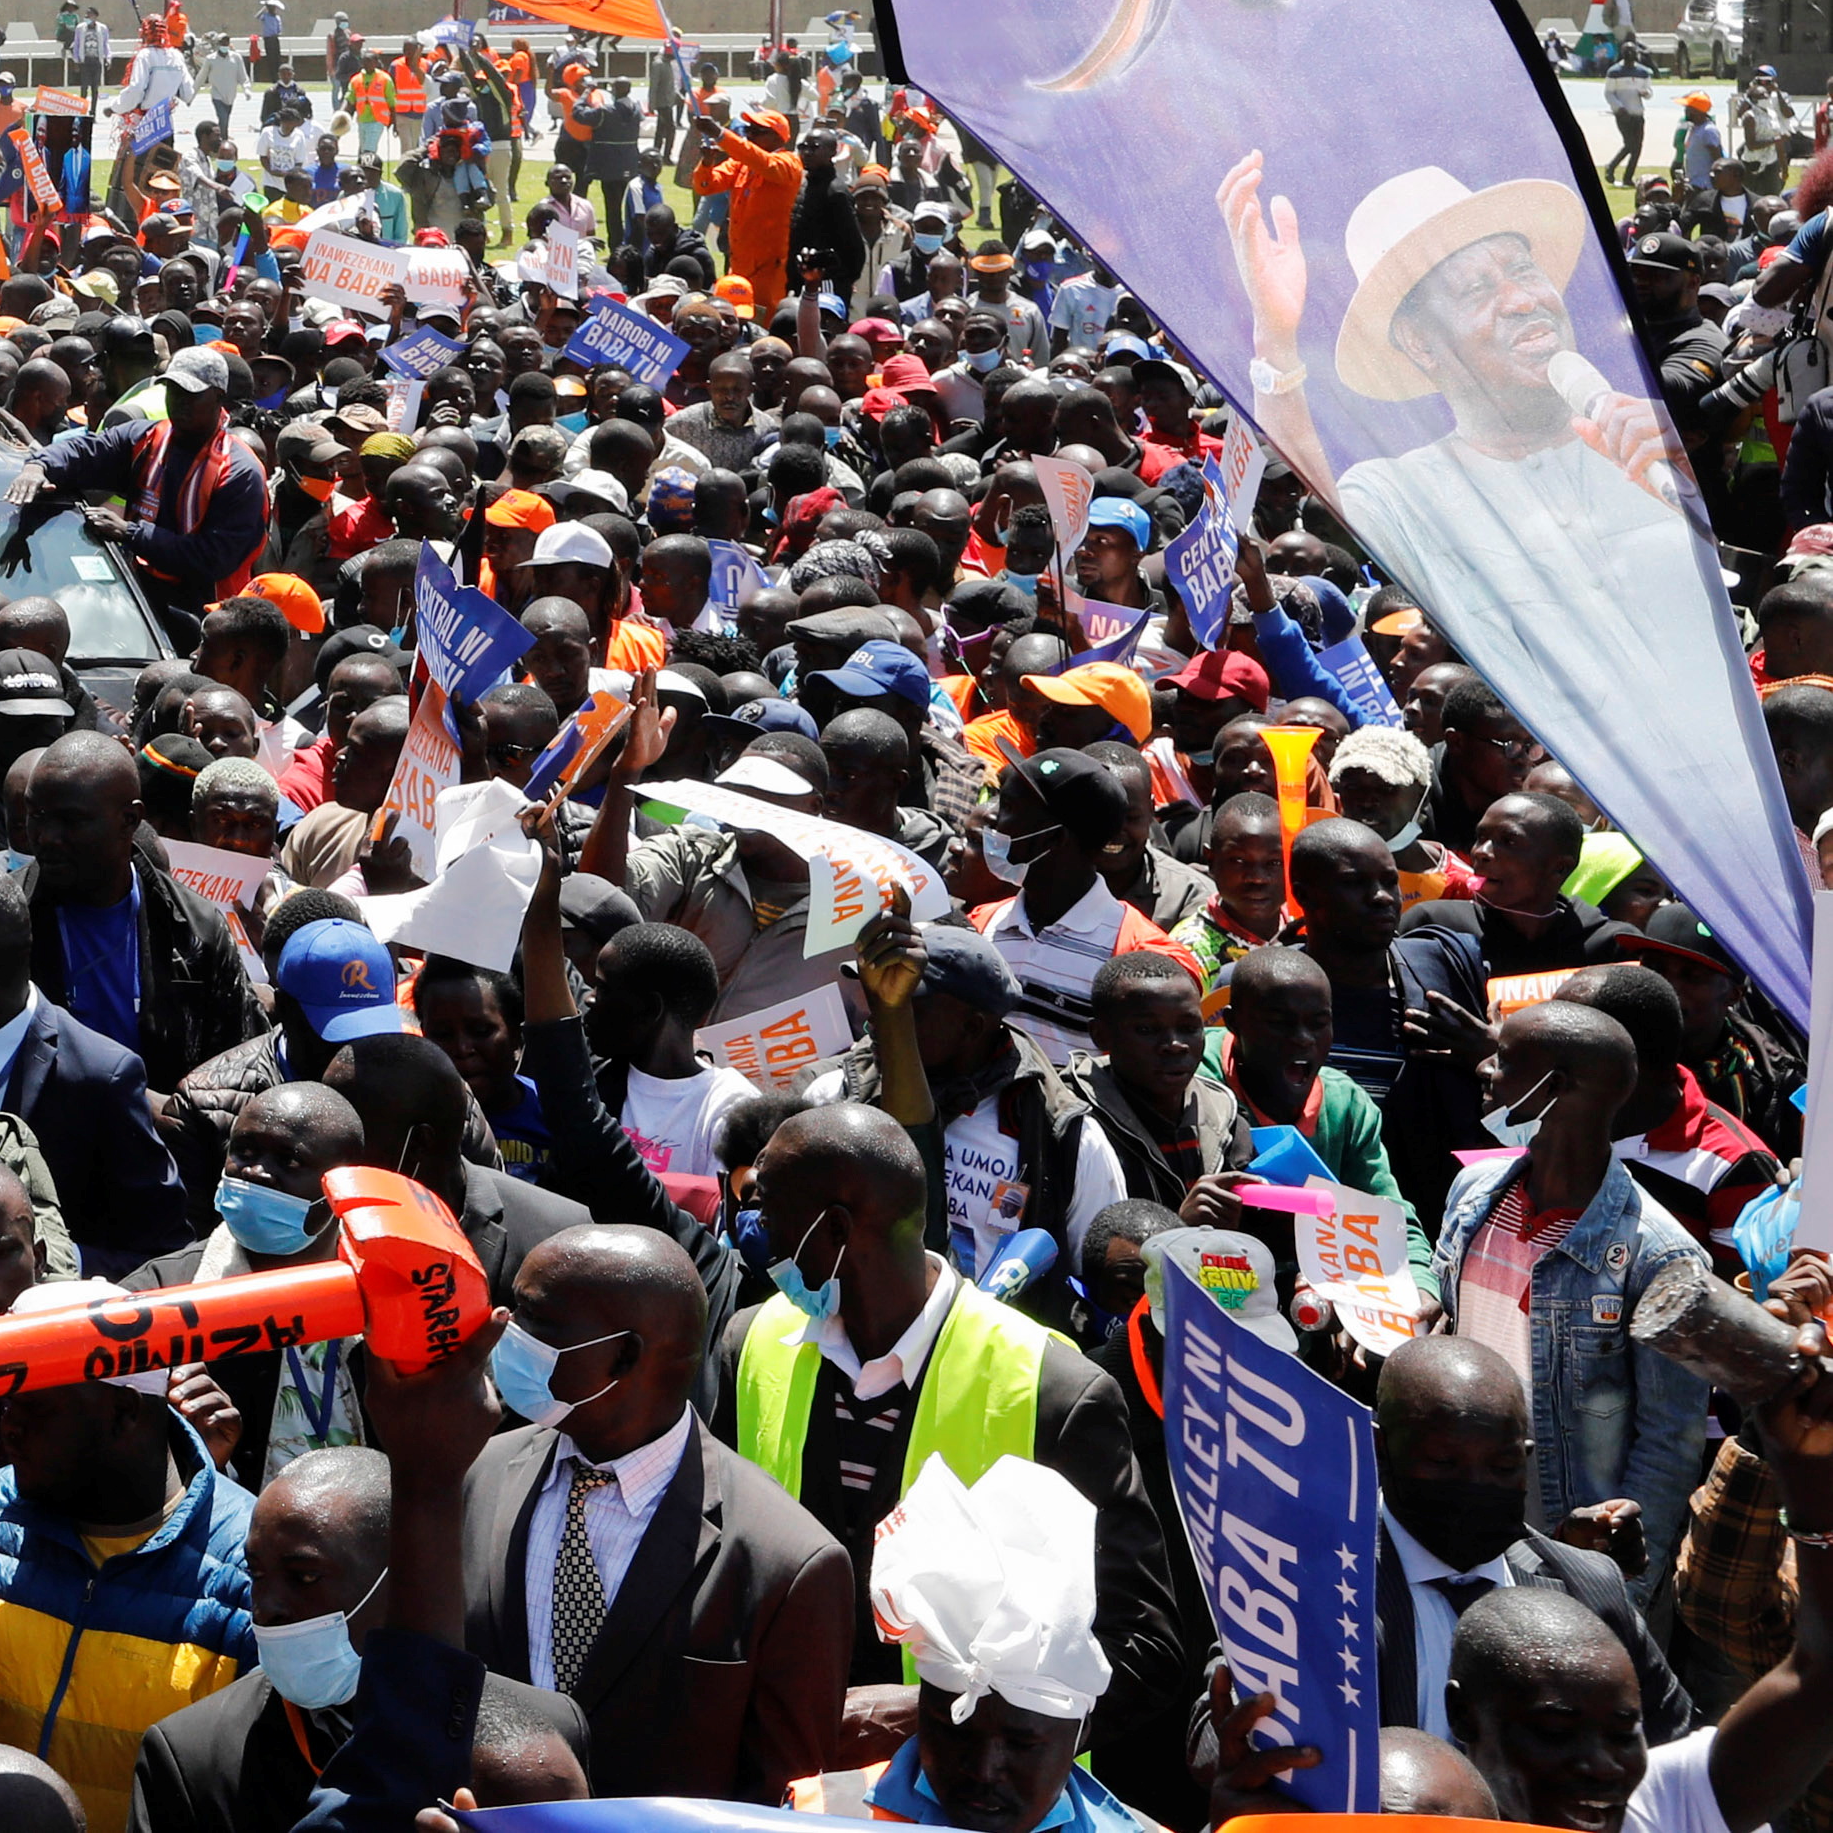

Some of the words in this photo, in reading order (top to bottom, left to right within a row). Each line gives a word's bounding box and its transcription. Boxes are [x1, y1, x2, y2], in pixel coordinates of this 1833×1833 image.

[303, 258, 331, 286] NA
[314, 242, 396, 279] INAWEZEKANA
[583, 323, 632, 365] BABA
[632, 352, 662, 385] TU
[597, 306, 653, 354] NAIROBI
[653, 339, 673, 364] NI
[399, 346, 440, 378] BAB
[454, 625, 494, 667] NI
[962, 1146, 1017, 1181] UMOJ
[83, 1314, 306, 1382] AZIMIO
[1183, 1319, 1223, 1392] NI
[1225, 1354, 1307, 1500] TU
